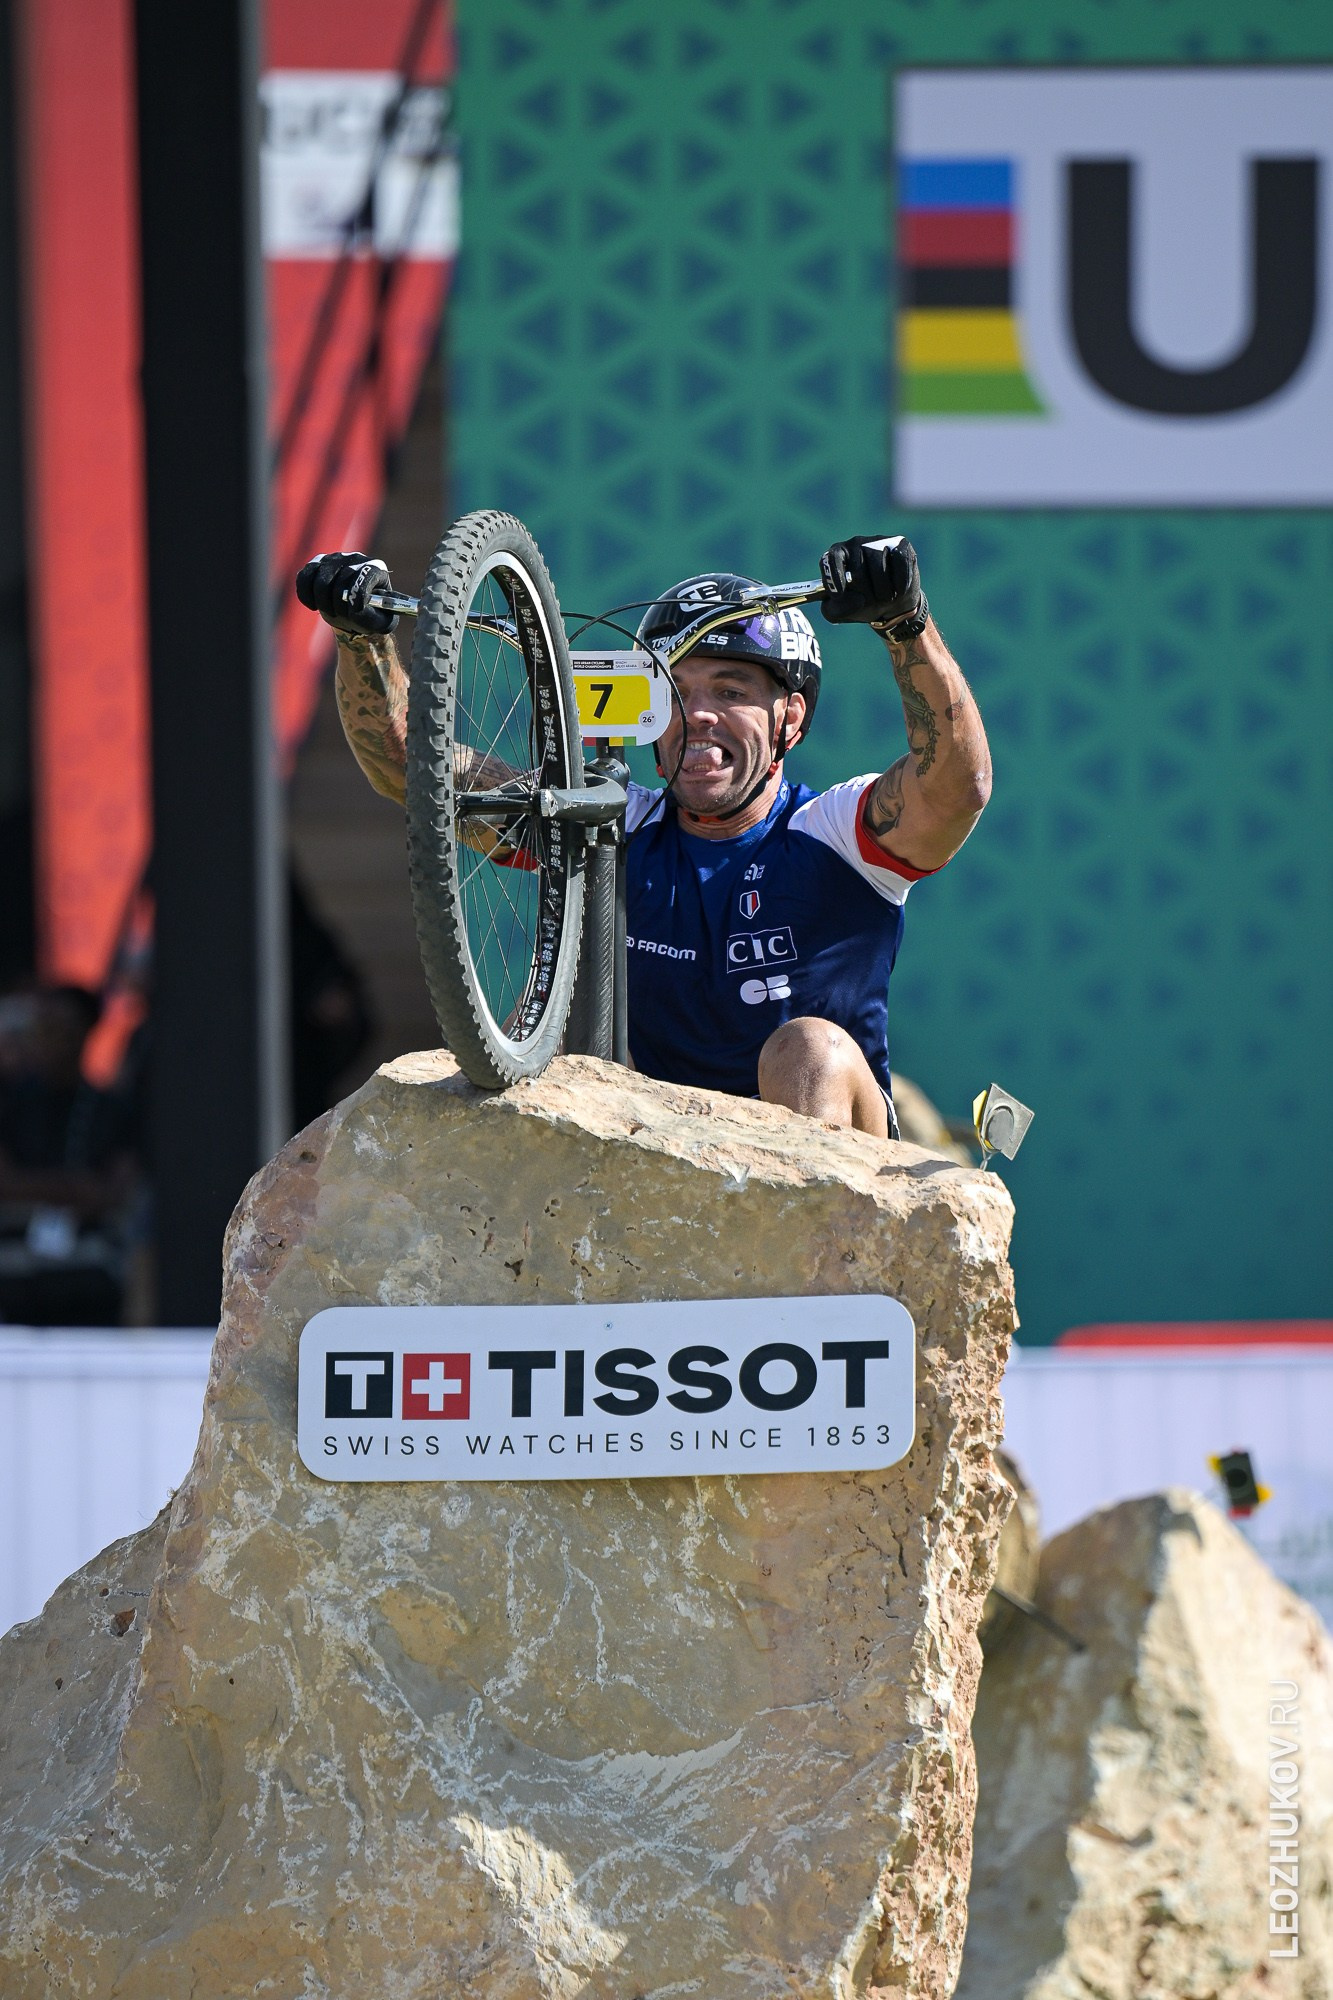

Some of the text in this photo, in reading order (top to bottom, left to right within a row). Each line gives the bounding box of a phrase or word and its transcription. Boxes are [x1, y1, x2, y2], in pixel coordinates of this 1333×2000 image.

[1063, 155, 1320, 422] U
[590, 683, 614, 720] 7
[637, 939, 697, 961] FACOM
[728, 935, 789, 964] CIC
[488, 1340, 890, 1418] TISSOT
[323, 1424, 892, 1457] SWISS WATCHES SINCE 1853
